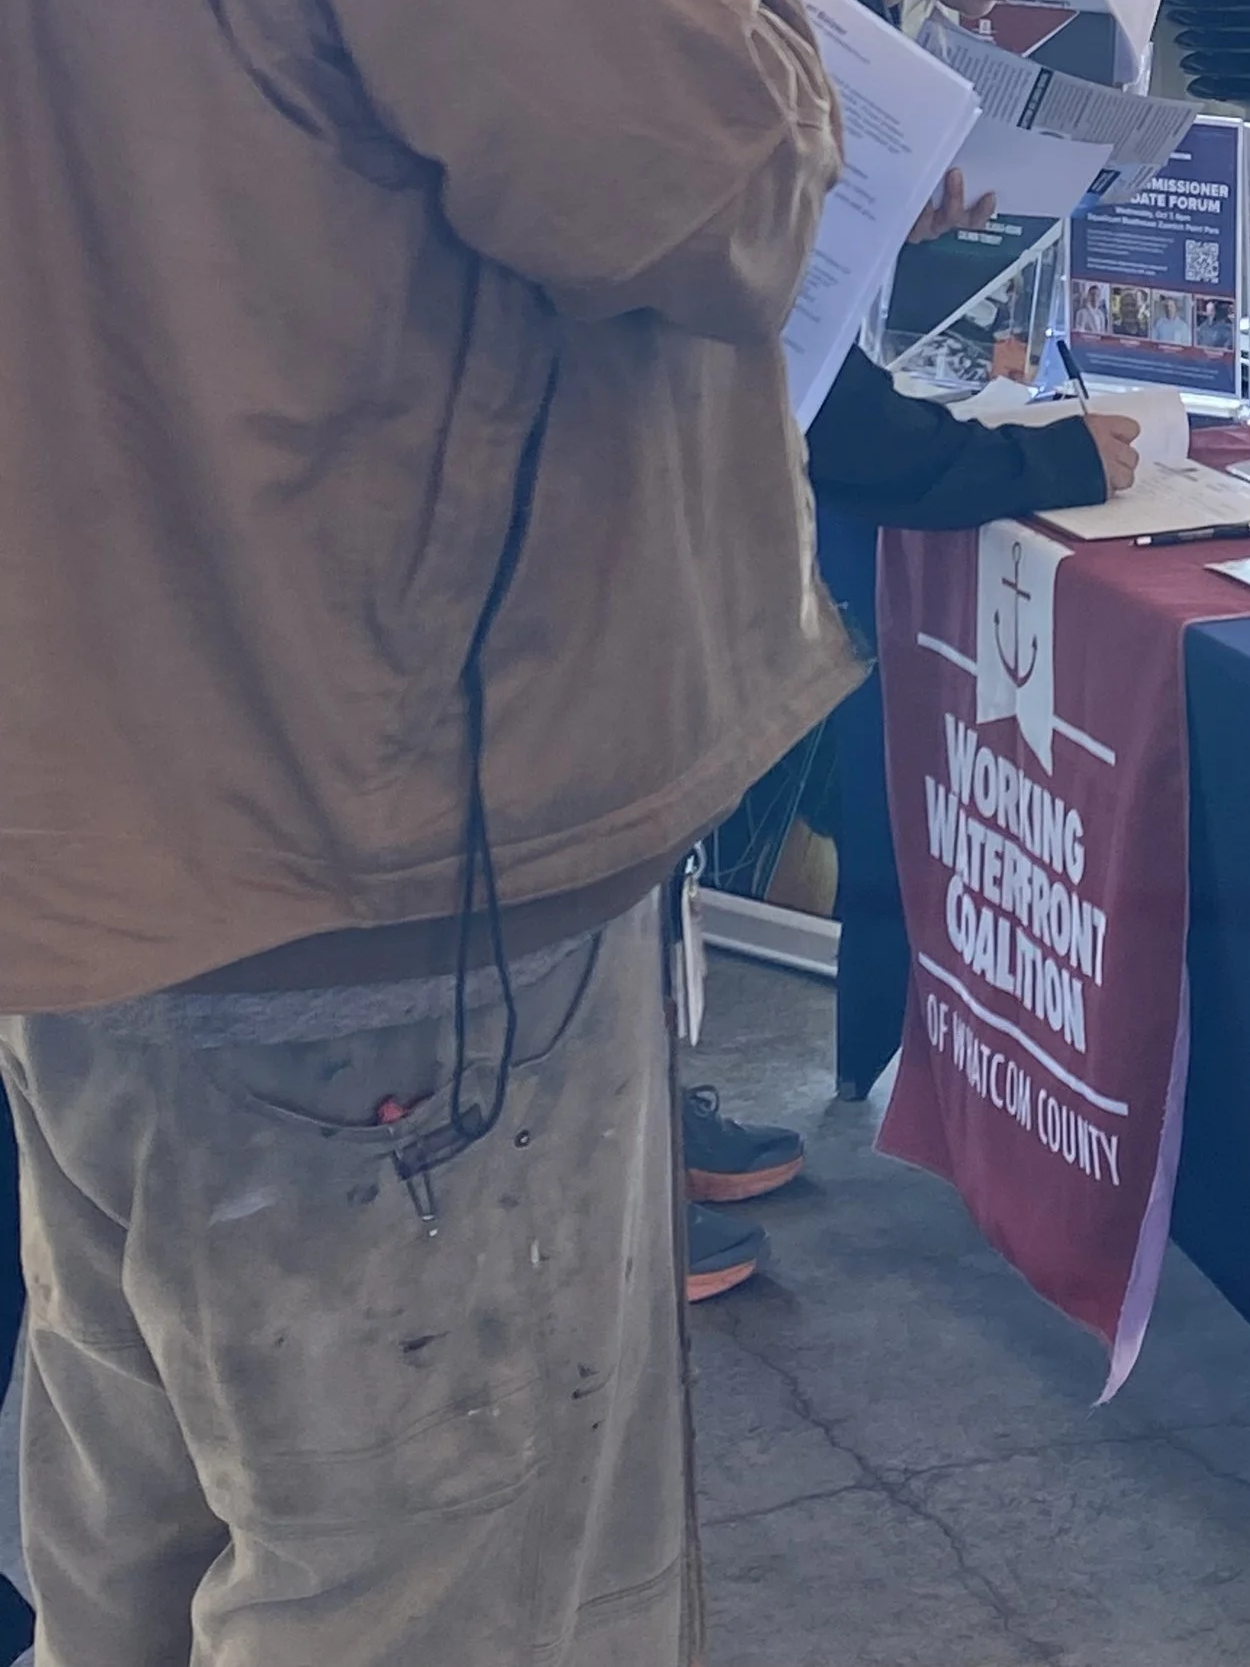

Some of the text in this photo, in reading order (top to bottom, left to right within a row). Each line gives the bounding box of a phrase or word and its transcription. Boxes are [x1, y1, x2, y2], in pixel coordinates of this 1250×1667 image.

[1147, 177, 1229, 198] MISSIONER
[1169, 194, 1221, 214] FORUM
[924, 776, 1107, 987] WATERFRONT
[944, 712, 1085, 885] WORKING
[946, 877, 1086, 1053] COALITION
[926, 992, 1121, 1185] OF WHATCOM COUNTY
